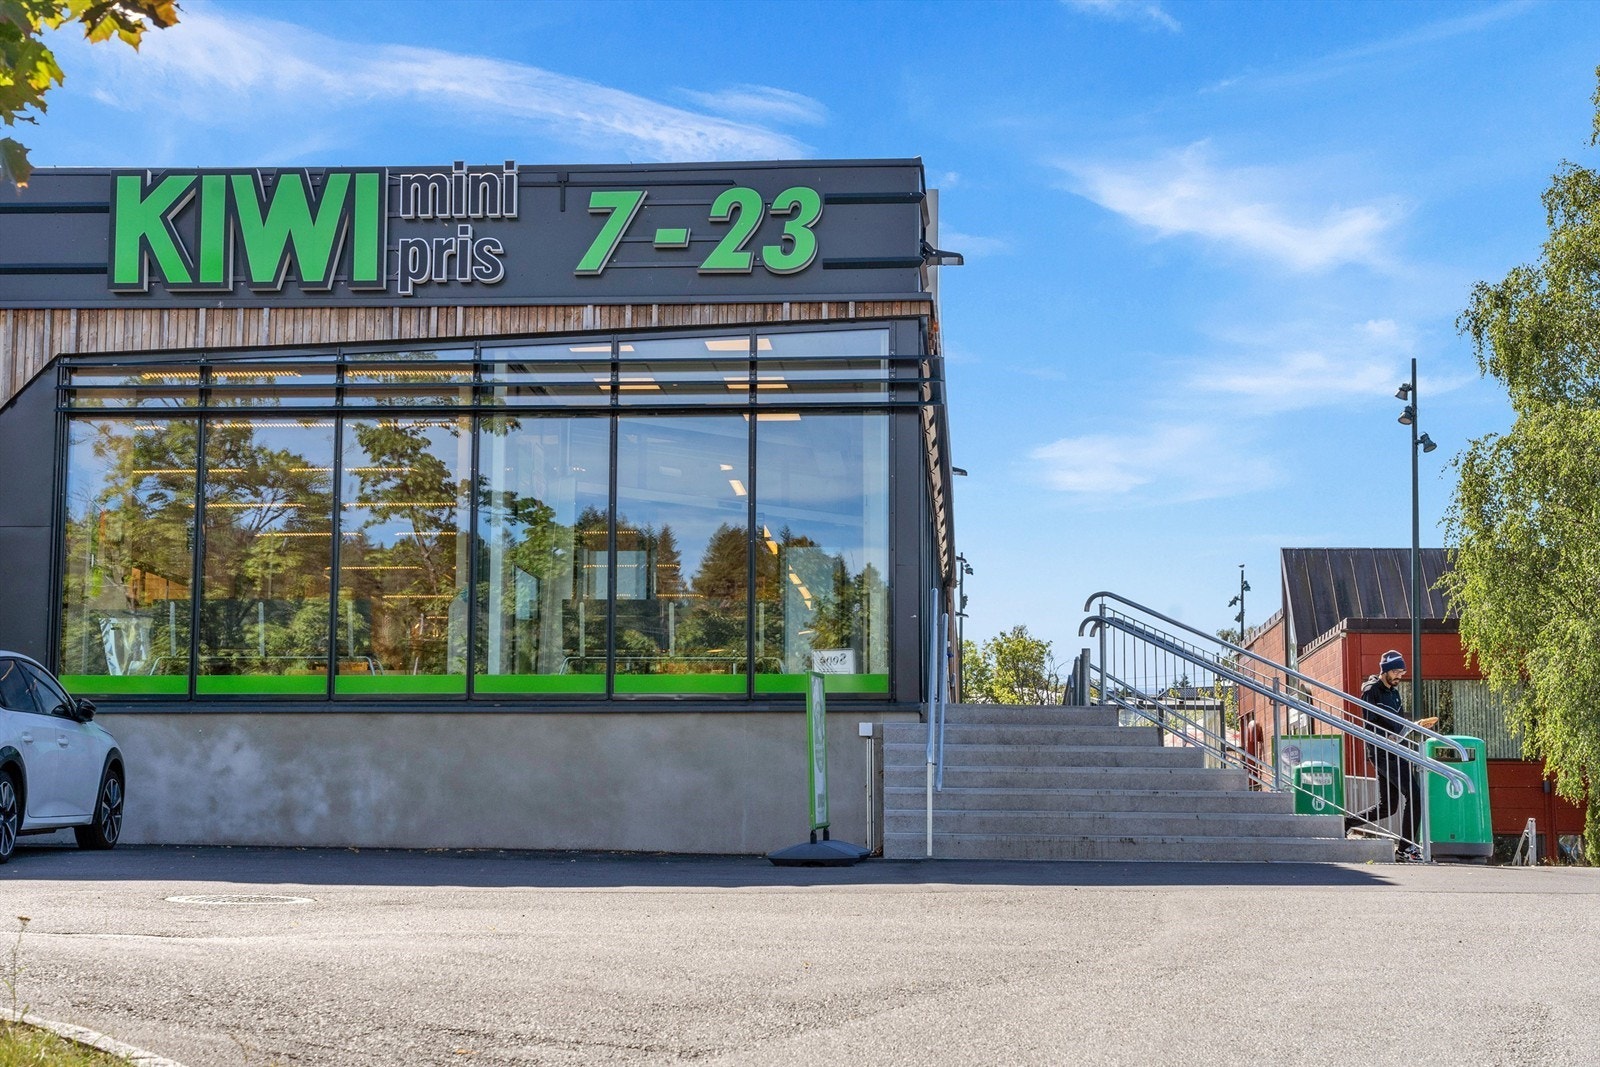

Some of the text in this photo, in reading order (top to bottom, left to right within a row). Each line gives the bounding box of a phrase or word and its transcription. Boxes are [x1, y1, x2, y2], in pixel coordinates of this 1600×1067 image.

[109, 169, 387, 290] KIWI
[399, 160, 519, 219] mini
[398, 224, 505, 295] pris
[575, 186, 824, 275] 7 - 23
